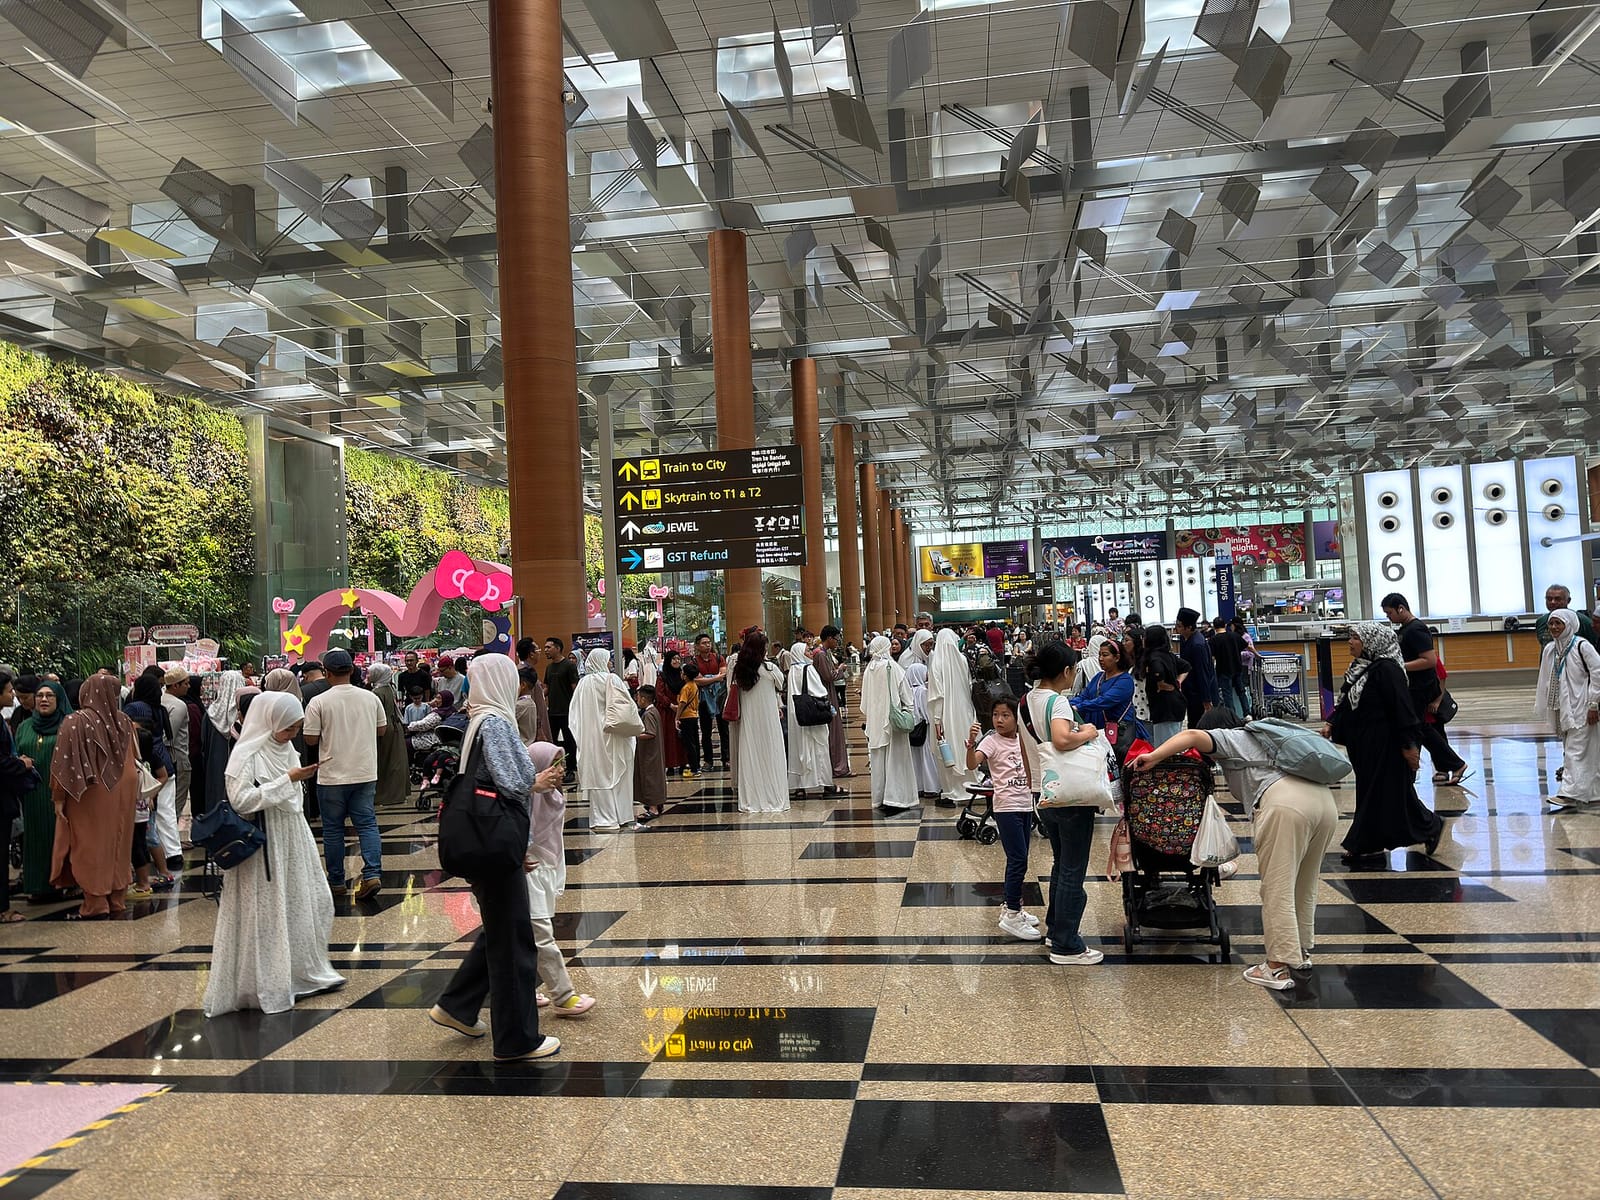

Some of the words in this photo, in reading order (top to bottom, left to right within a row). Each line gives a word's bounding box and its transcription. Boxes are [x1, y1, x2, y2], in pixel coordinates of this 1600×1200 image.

[663, 461, 689, 473] Train
[691, 461, 703, 471] to
[706, 459, 727, 472] City
[664, 491, 707, 505] Skytrain
[709, 491, 721, 500] to
[723, 488, 735, 499] T1
[739, 490, 746, 498] &
[748, 486, 761, 497] T2
[665, 521, 699, 533] JEWEL
[1225, 536, 1250, 545] Dining
[1231, 542, 1259, 553] elights
[667, 551, 688, 562] GST
[690, 548, 728, 561] Refund
[1381, 552, 1406, 582] 6
[1219, 567, 1229, 601] Trolleys
[1144, 595, 1155, 609] 8
